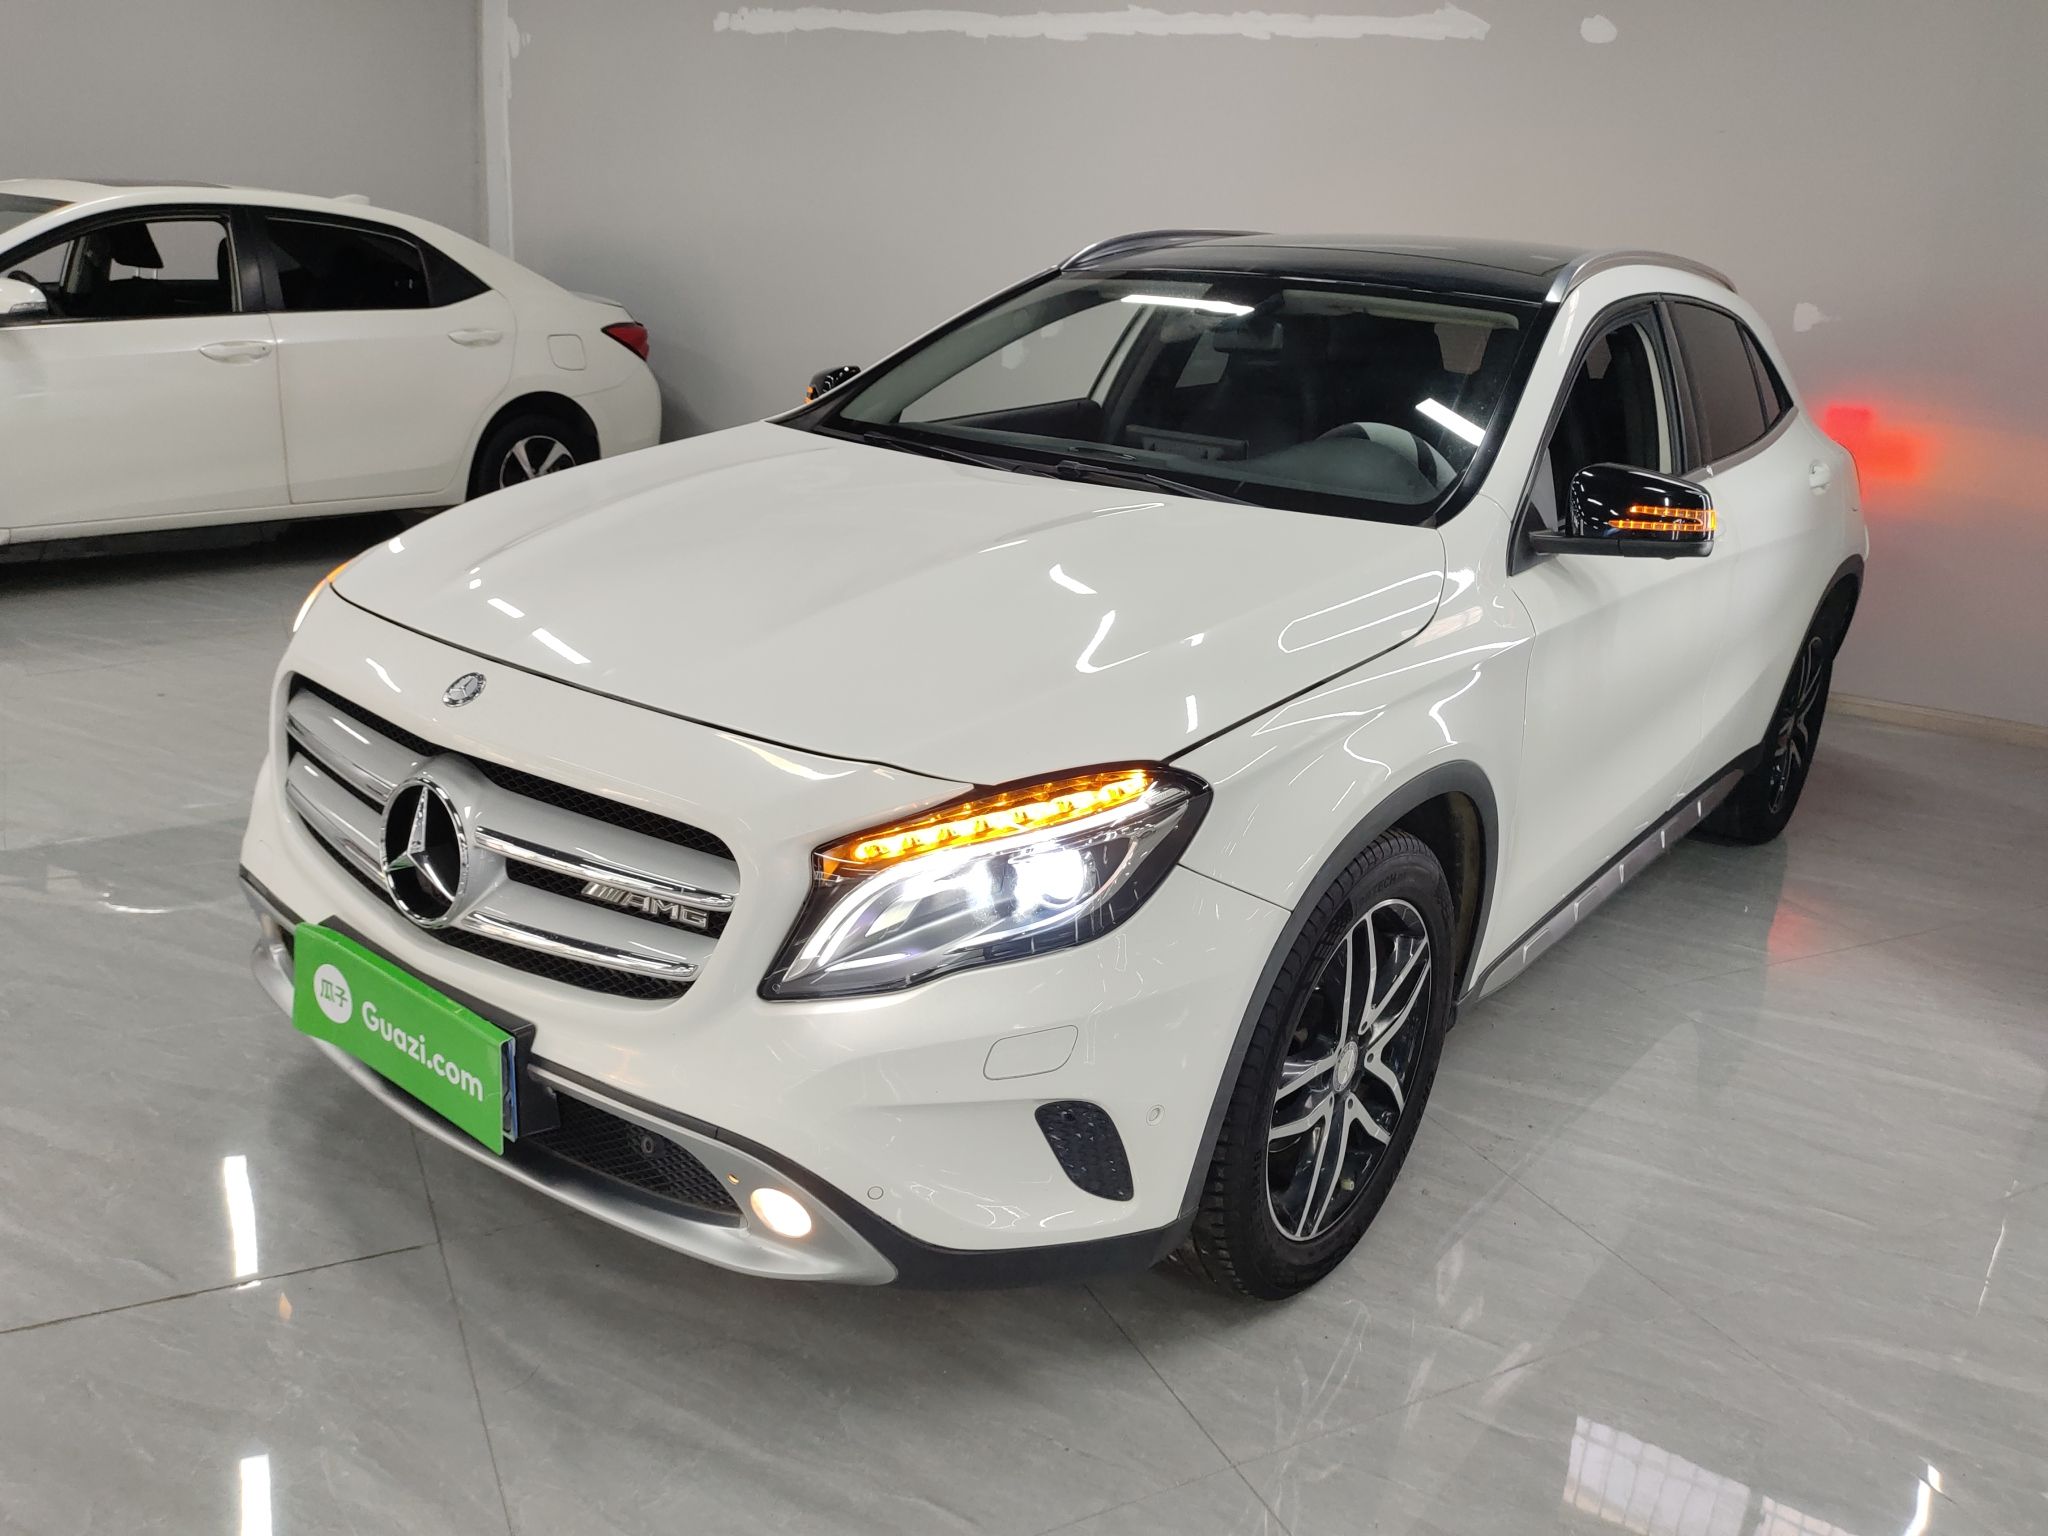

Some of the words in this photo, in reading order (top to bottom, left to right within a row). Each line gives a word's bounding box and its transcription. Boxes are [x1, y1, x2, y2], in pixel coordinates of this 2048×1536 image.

[620, 891, 708, 928] AMG
[321, 979, 348, 1007] 瓜子
[362, 1001, 484, 1102] Guazi.com
